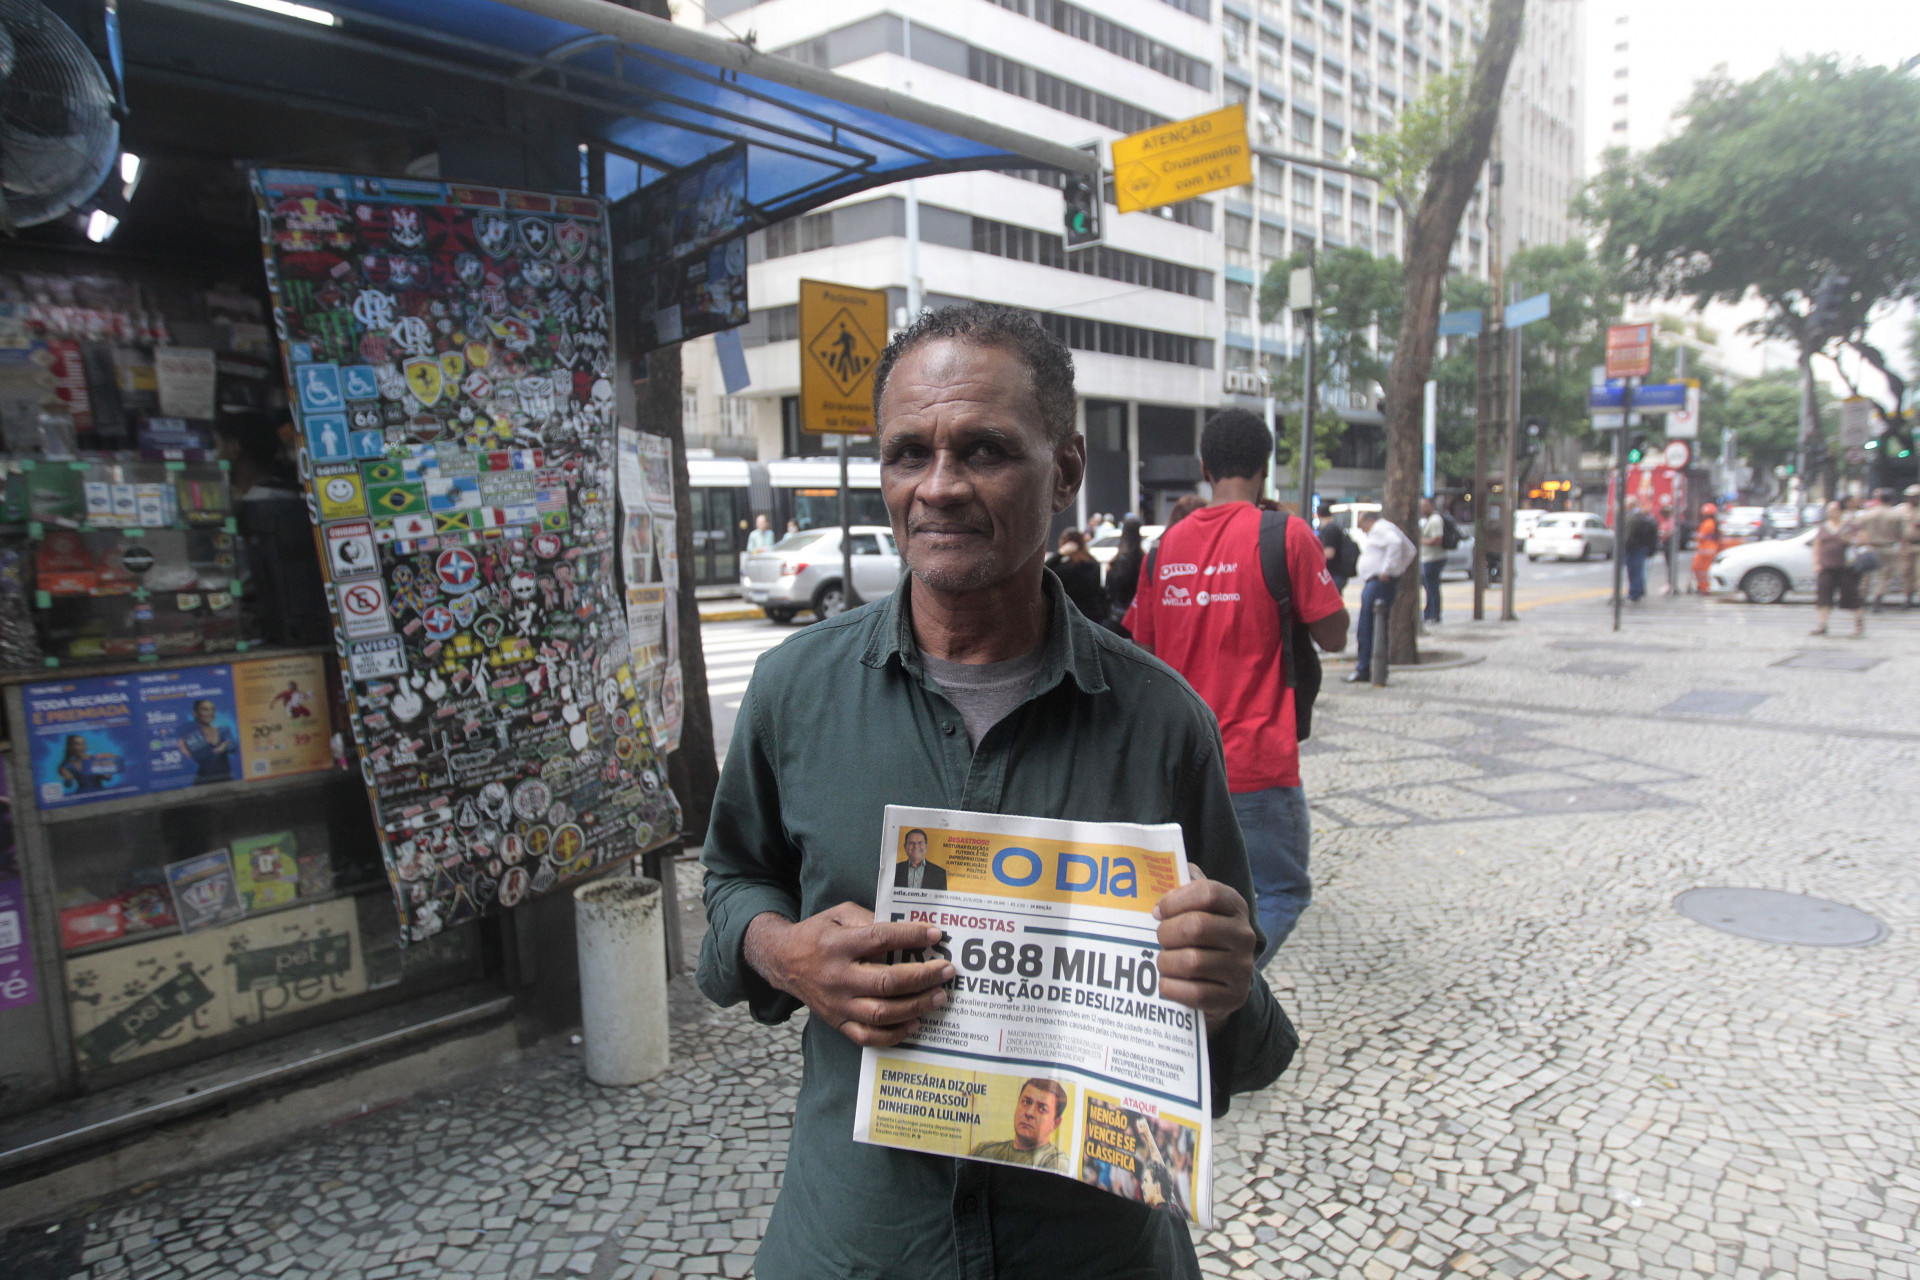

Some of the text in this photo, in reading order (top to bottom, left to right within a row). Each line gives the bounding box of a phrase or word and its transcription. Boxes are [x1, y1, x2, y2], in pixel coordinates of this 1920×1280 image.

[1141, 119, 1213, 151] ATENÇÃO
[1161, 143, 1242, 174] Cruzamento
[1175, 164, 1232, 190] com VLT
[1162, 597, 1192, 607] WELLA
[354, 638, 398, 654] AVISO
[947, 836, 990, 846] DESASTROSO
[992, 847, 1043, 887] O
[893, 890, 928, 898] odia.com.br
[910, 910, 1016, 933] PAC ENCOSTAS
[960, 937, 1043, 978] 688
[1052, 946, 1160, 997] MILHÕ
[942, 974, 1193, 1031] REVENÇÃO DE DESLIZAMENTOS
[955, 996, 988, 1007] Cavaliere
[989, 1002, 1020, 1012] promete
[1021, 1003, 1036, 1013] 330
[1037, 1005, 1081, 1019] intervenções
[1124, 1022, 1143, 1033] cidade
[938, 1006, 968, 1016] revenção
[970, 1008, 998, 1019] buscam
[999, 1012, 1024, 1022] reduzir
[1035, 1015, 1068, 1028] impactos
[942, 1029, 960, 1037] COMO
[970, 1033, 989, 1042] RISCO
[1111, 1056, 1148, 1072] RECUPERAÇÃO
[1149, 1066, 1156, 1074] DE
[1112, 1048, 1129, 1058] SERÃO
[1130, 1053, 1147, 1063] OBRAS
[1148, 1057, 1155, 1065] DE
[881, 1069, 987, 1096] EMPRESÁRIA DIZ QUE
[1114, 1066, 1141, 1080] PROTEÇÃO
[879, 1084, 969, 1108] NUNCA REPASSOU
[1122, 1096, 1157, 1115] ATAQUE
[877, 1099, 981, 1125] DINHEIRO A LULINHA
[1090, 1105, 1128, 1130] MENGÃO
[1088, 1122, 1136, 1153] VENCE E SE
[1086, 1141, 1136, 1173] CLASSIFICA
